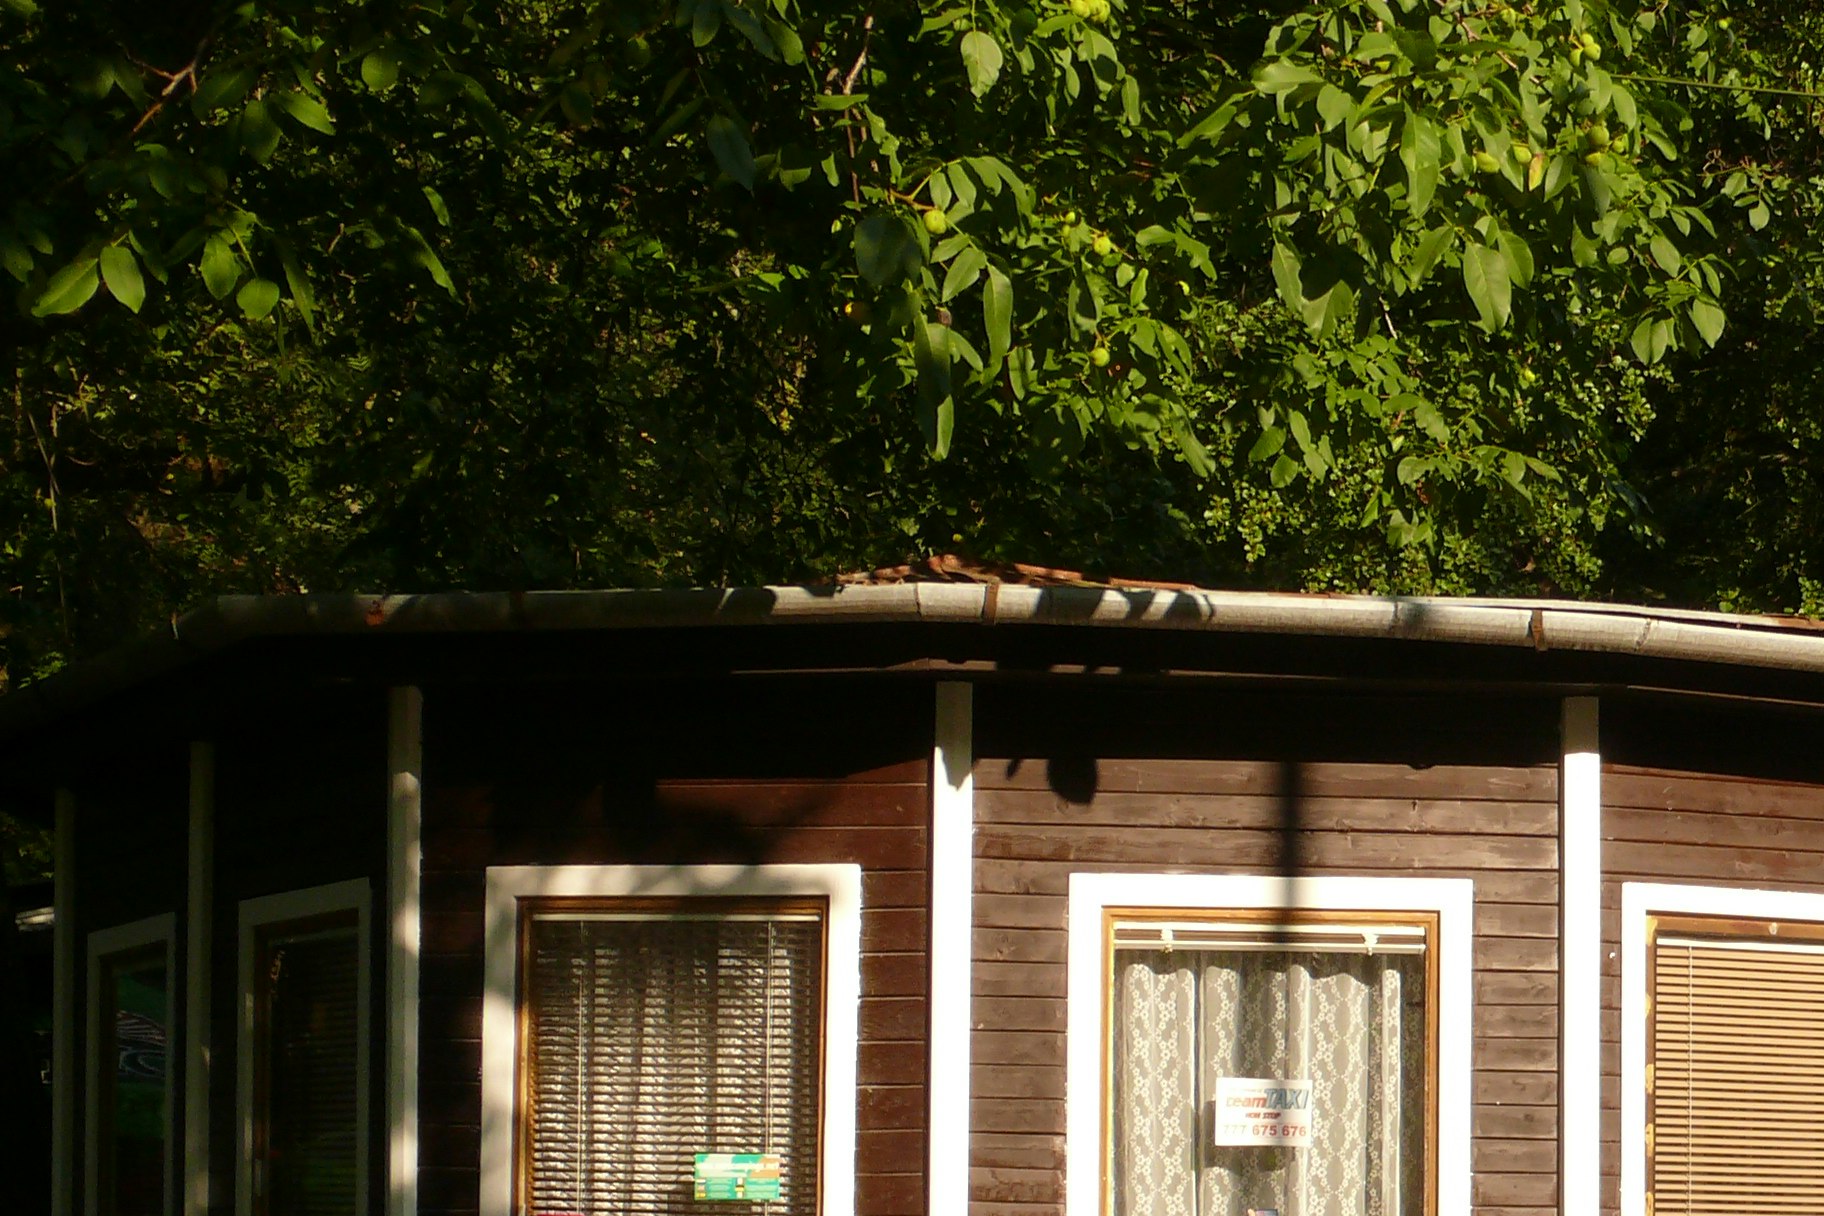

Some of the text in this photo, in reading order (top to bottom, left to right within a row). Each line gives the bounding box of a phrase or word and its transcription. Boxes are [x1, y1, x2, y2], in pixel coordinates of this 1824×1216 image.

[1223, 1124, 1307, 1137] 777 675 676
